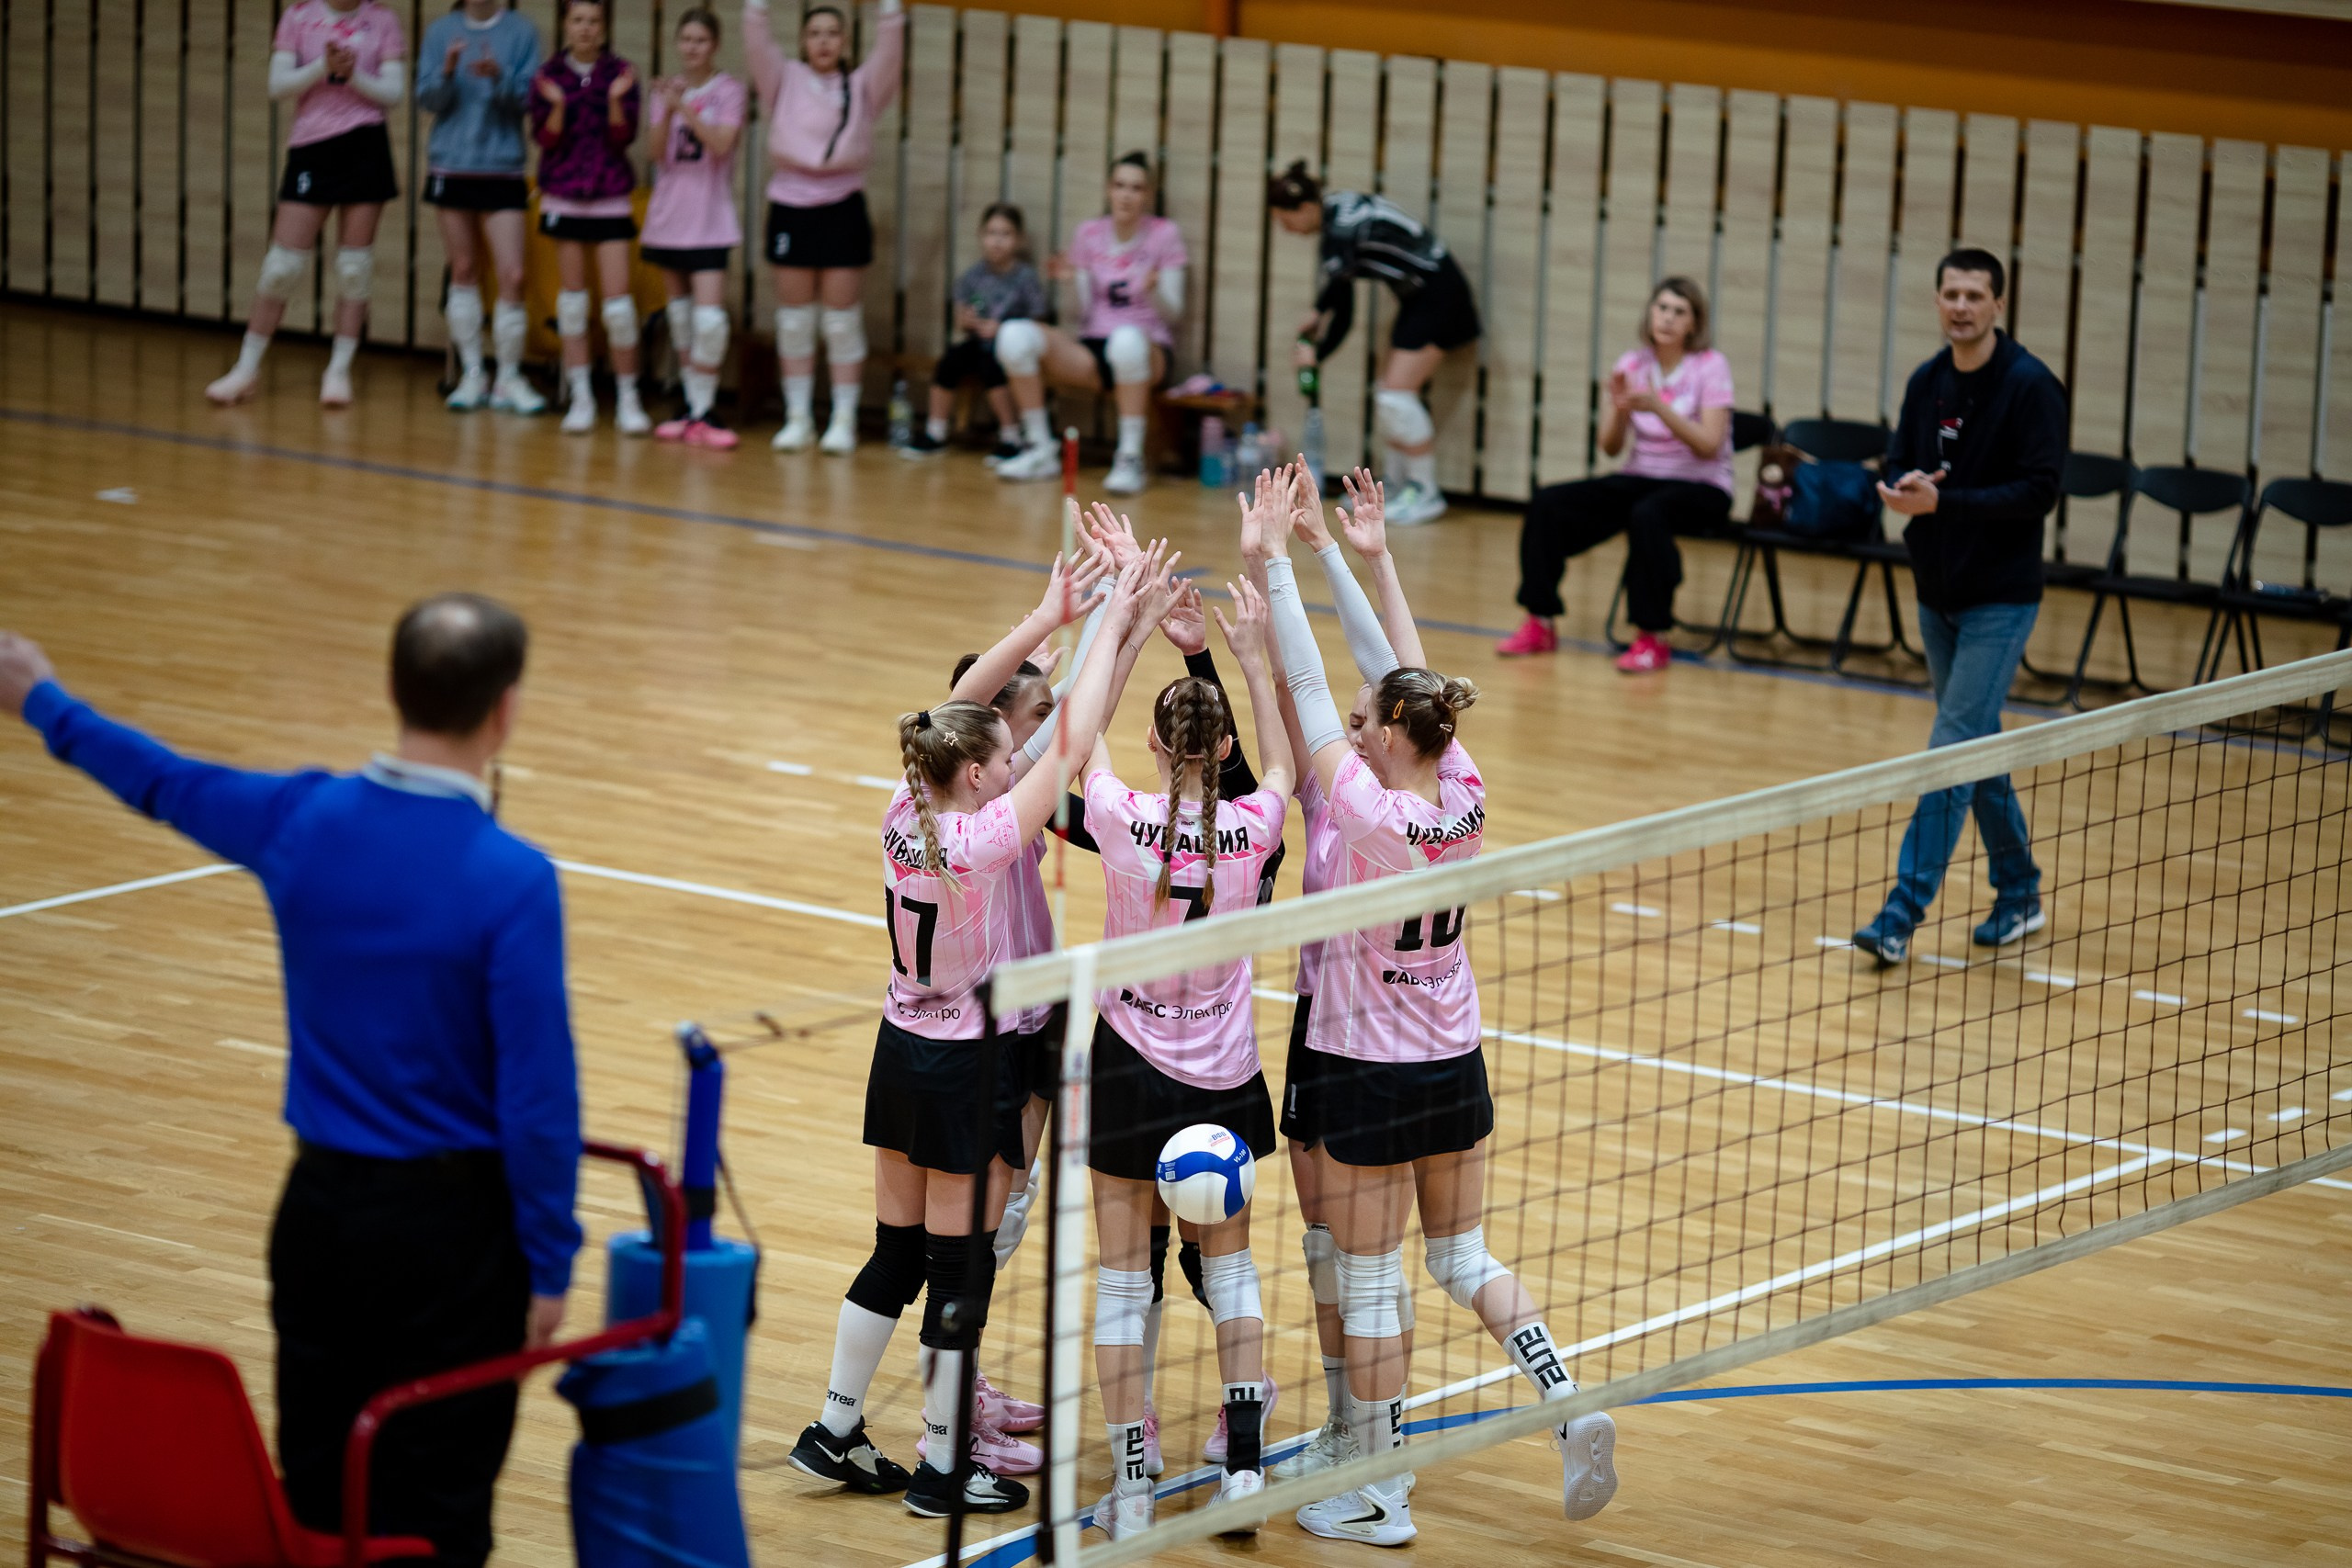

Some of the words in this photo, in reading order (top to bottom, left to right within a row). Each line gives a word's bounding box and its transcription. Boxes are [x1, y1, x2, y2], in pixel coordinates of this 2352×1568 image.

[884, 825, 948, 871] ЧУВАШЯ
[885, 883, 938, 988] 17
[1512, 1325, 1567, 1391] ELITE
